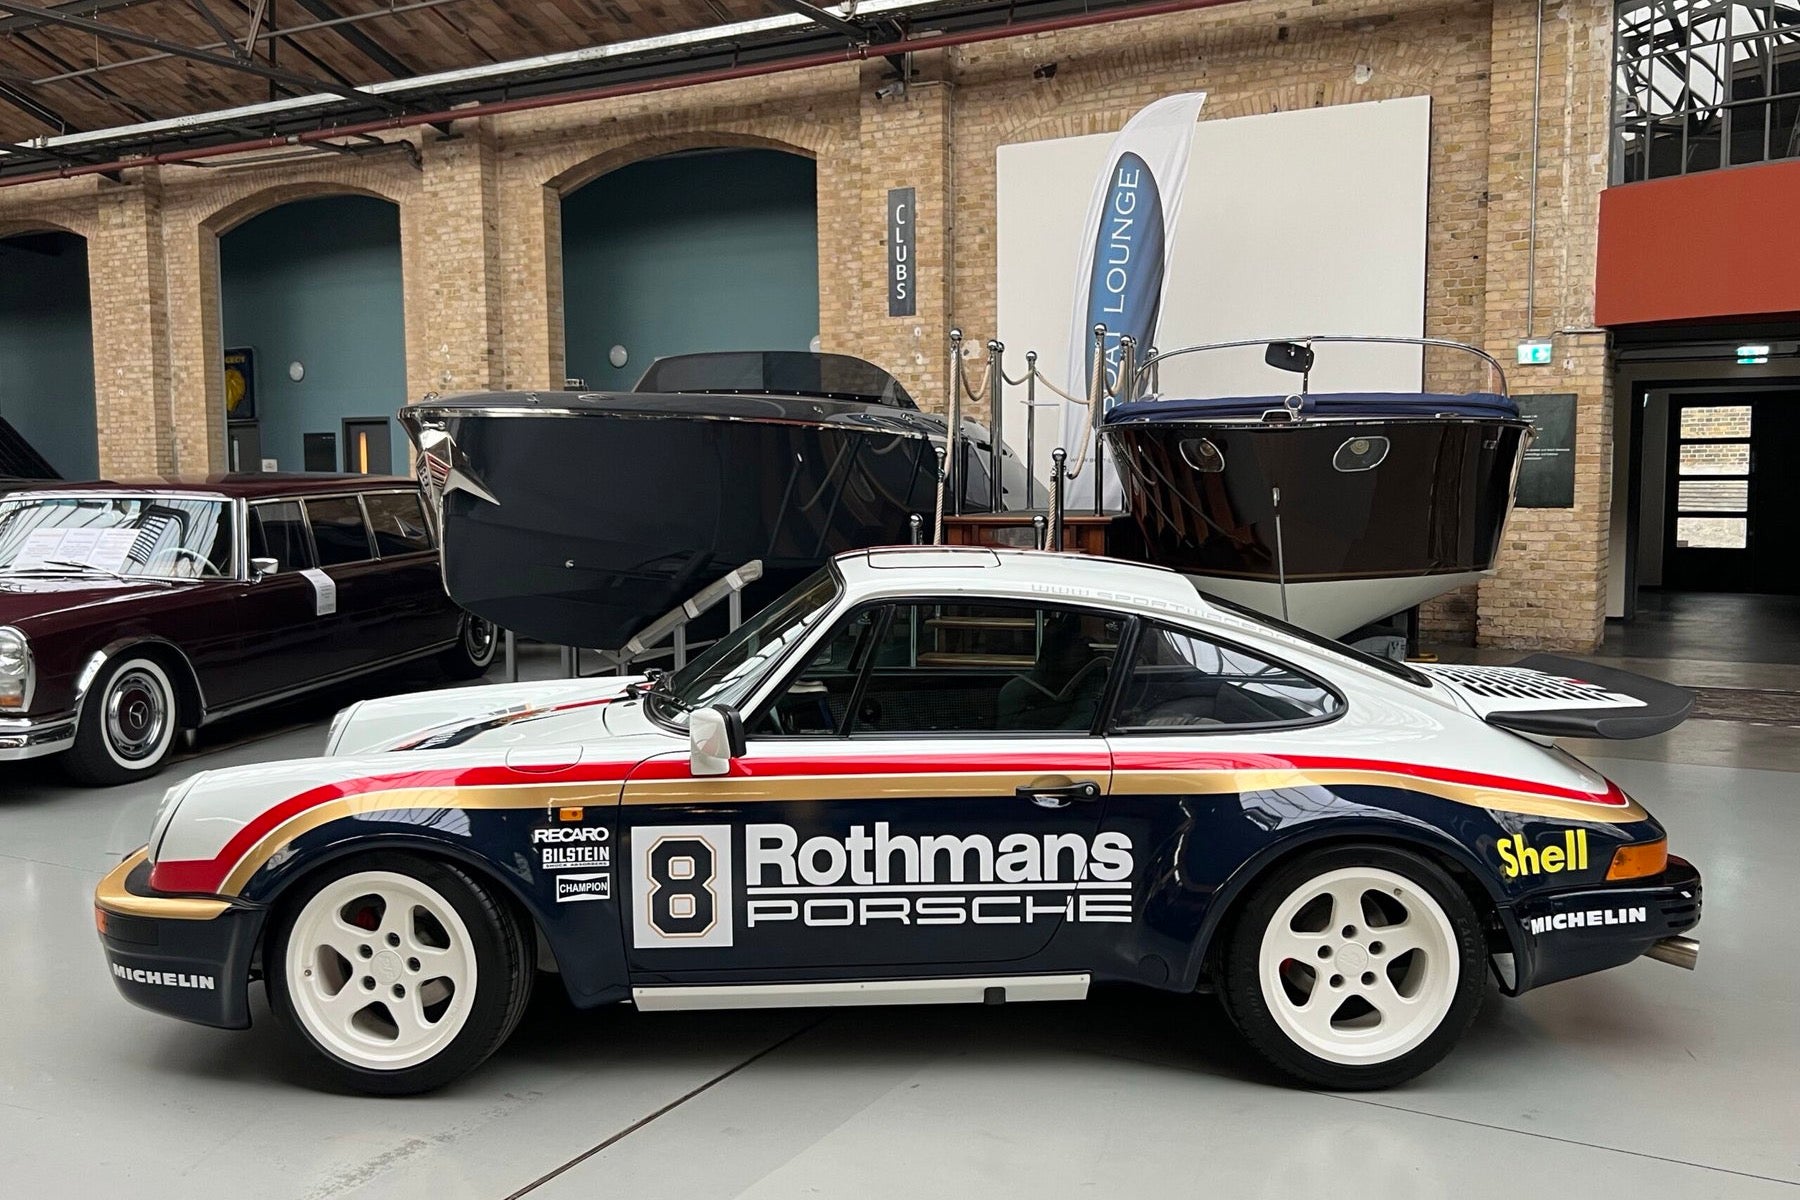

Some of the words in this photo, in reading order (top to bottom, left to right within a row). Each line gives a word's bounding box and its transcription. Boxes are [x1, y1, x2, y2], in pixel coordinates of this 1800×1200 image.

[896, 204, 907, 300] CLUBS
[1104, 168, 1140, 313] LOUNGE
[533, 827, 609, 843] RECARO
[542, 846, 609, 863] BILSTEIN
[745, 821, 1134, 886] Rothmans
[1496, 829, 1588, 878] Shell
[559, 881, 608, 893] CHAMPION
[646, 835, 717, 938] 8
[747, 894, 1132, 928] PORSCHE
[1531, 906, 1647, 935] MICHELIN
[112, 962, 215, 990] MICHELIN
